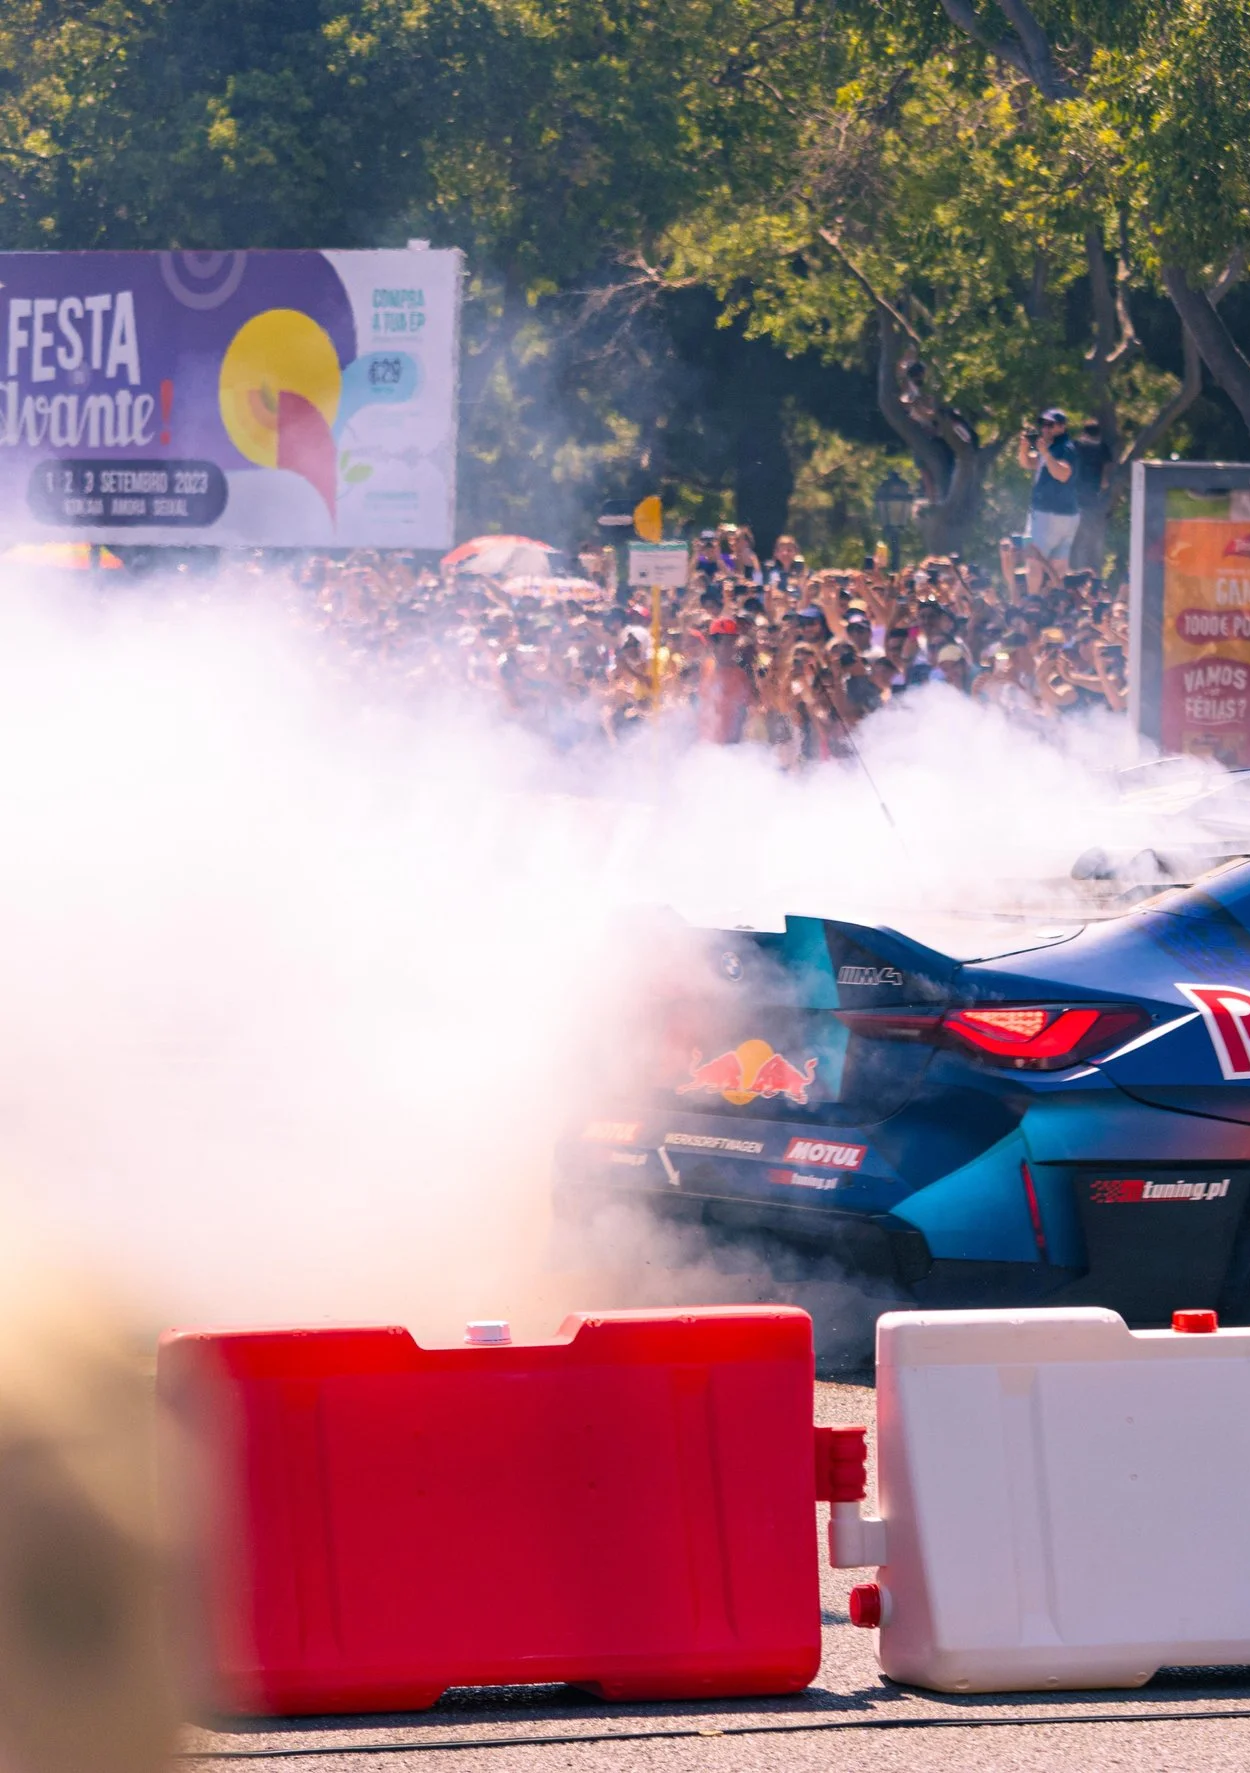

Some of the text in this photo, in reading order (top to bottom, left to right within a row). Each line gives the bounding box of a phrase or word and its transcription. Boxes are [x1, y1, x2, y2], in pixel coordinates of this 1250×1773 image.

[7, 291, 141, 386] FESTA
[101, 471, 168, 493] SETEMBRO
[173, 472, 209, 494] 2023
[1184, 665, 1248, 692] VAMOS
[1184, 696, 1247, 720] FÉRIAS?
[787, 1141, 861, 1167] MOTUL
